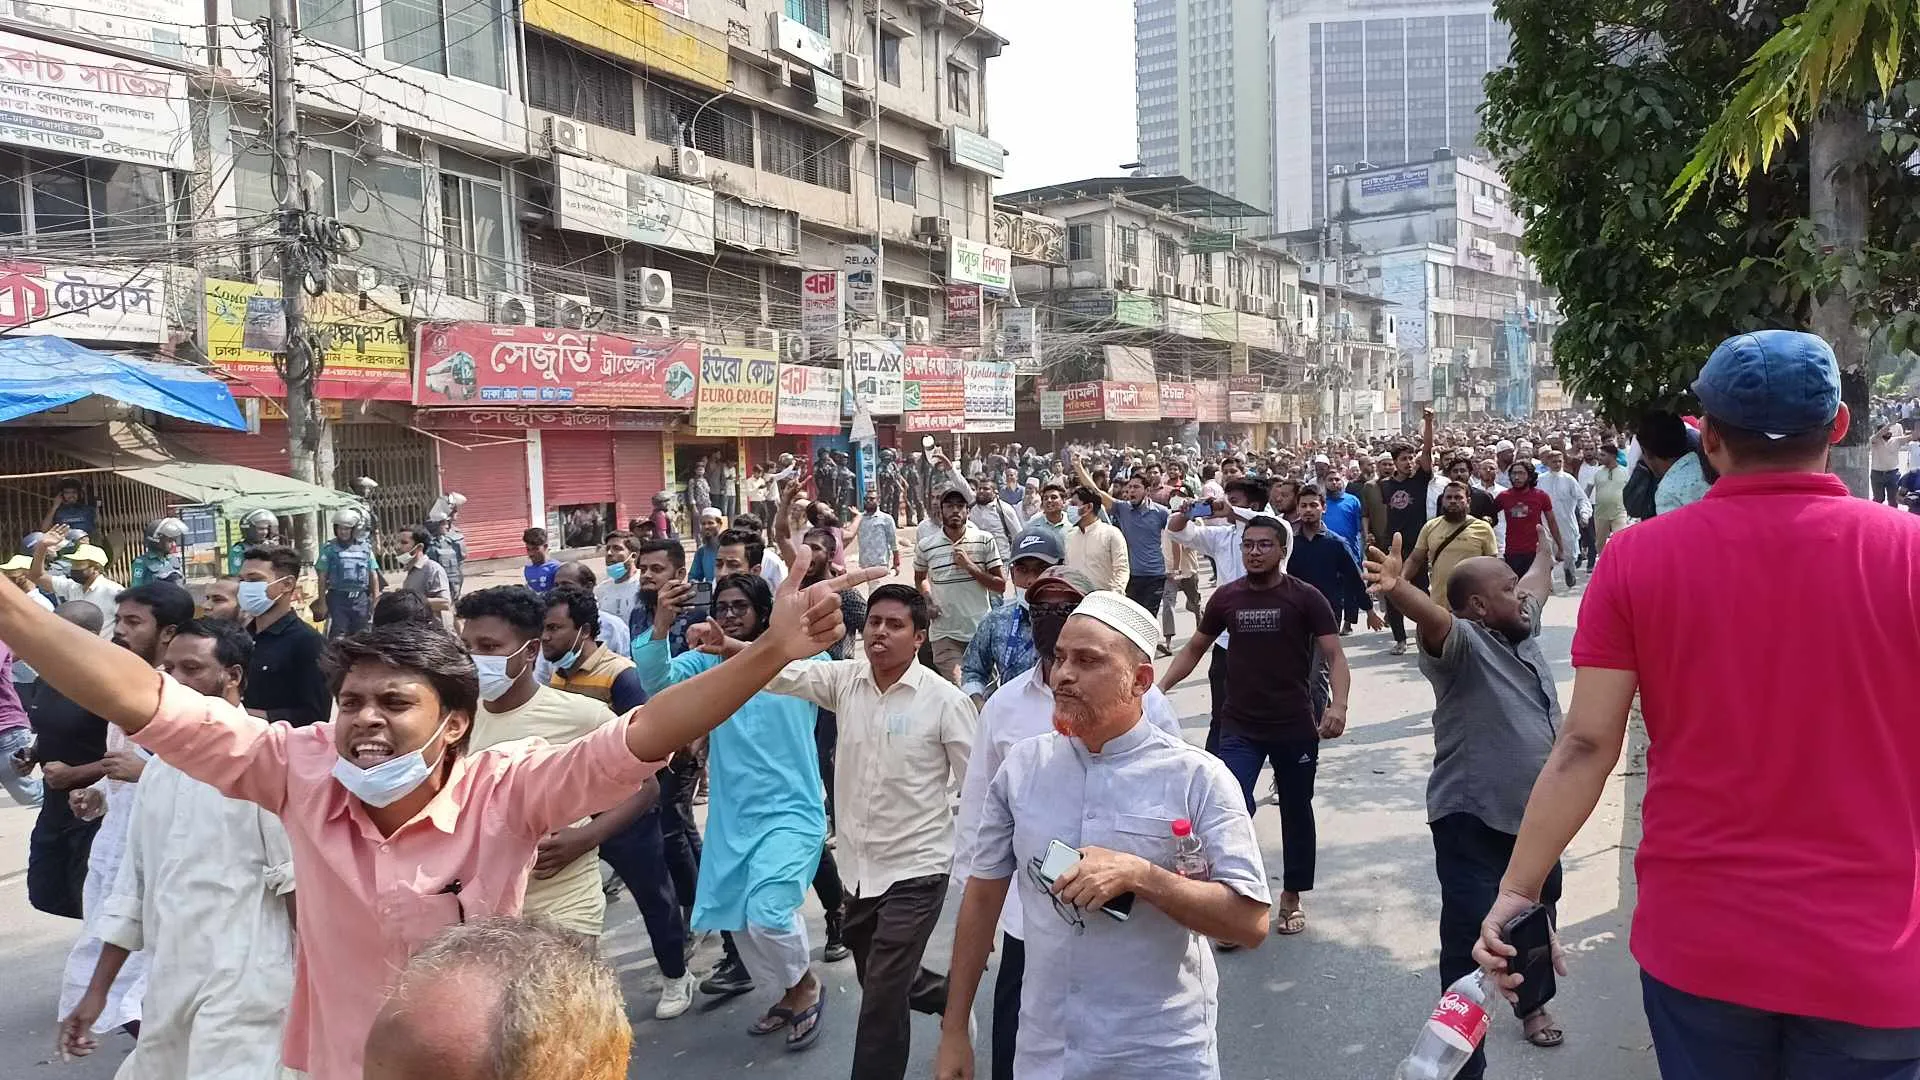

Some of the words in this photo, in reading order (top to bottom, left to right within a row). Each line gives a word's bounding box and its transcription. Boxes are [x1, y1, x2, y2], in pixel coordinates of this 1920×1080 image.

[80, 63, 172, 97] সার্ভিস
[845, 256, 877, 265] RELAX
[957, 250, 979, 273] সবুজ
[983, 248, 1006, 275] নিশান
[805, 273, 835, 294] এনা
[216, 347, 241, 357] ঢাকা
[847, 351, 902, 373] RELAX
[702, 348, 743, 386] ইউরো
[746, 358, 777, 386] কোচ
[701, 388, 734, 403] EURO
[736, 389, 774, 405] COACH
[1238, 611, 1278, 625] PERFECT
